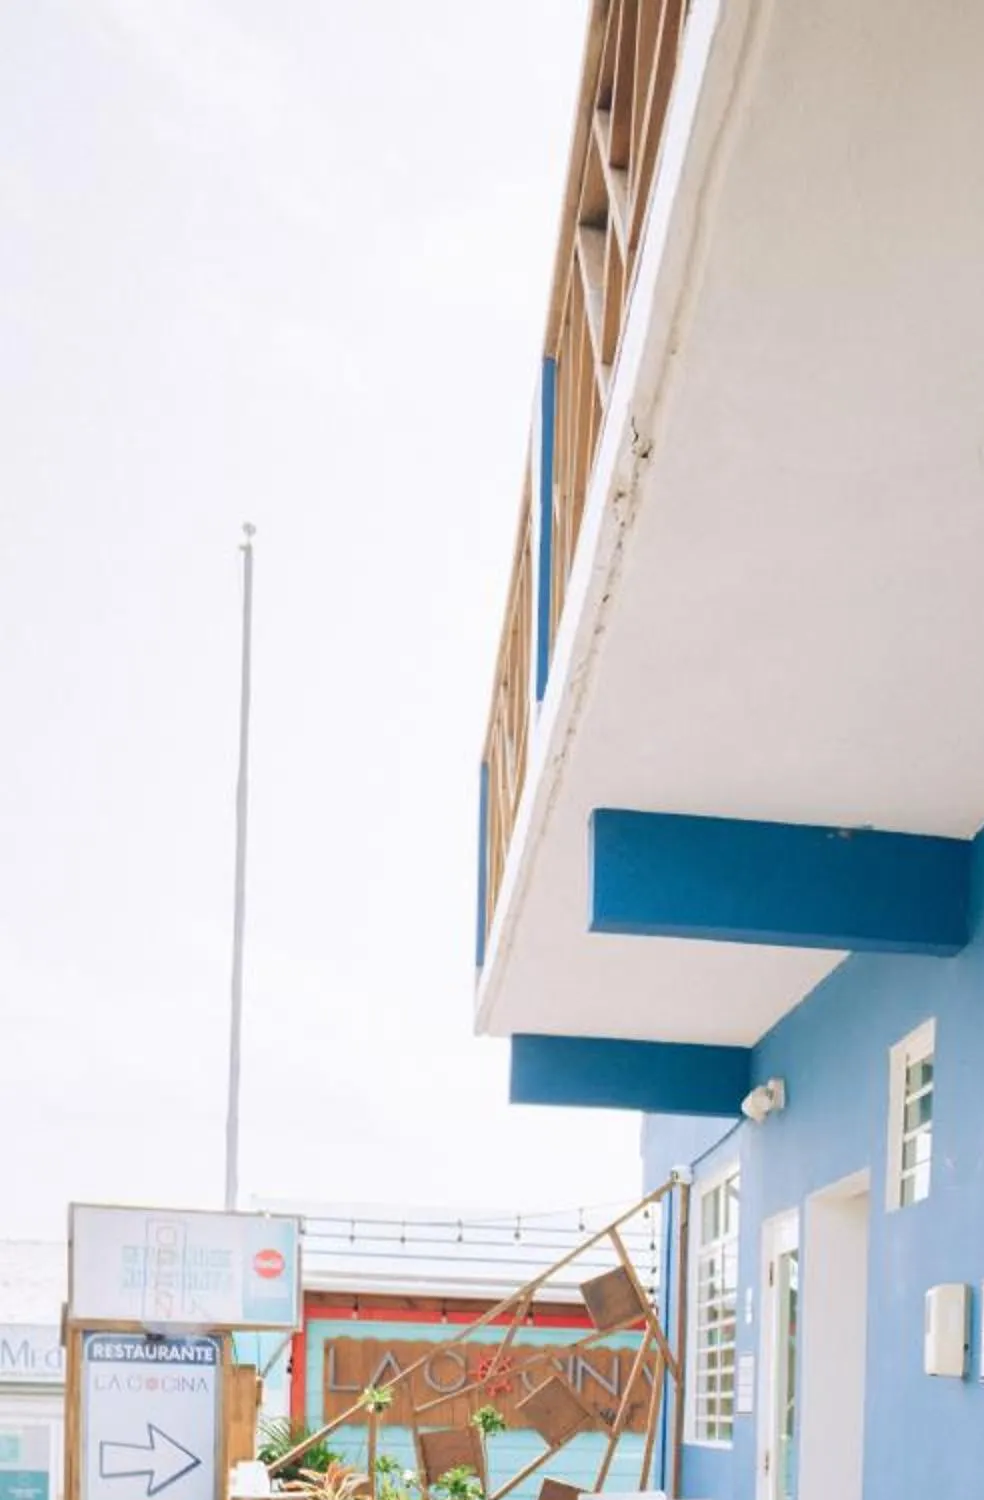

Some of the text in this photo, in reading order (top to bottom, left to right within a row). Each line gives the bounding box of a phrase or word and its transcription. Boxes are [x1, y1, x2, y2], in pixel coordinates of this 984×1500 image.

[93, 1343, 214, 1362] RESTAURANTE
[329, 1344, 406, 1393] LA
[94, 1373, 122, 1392] LA
